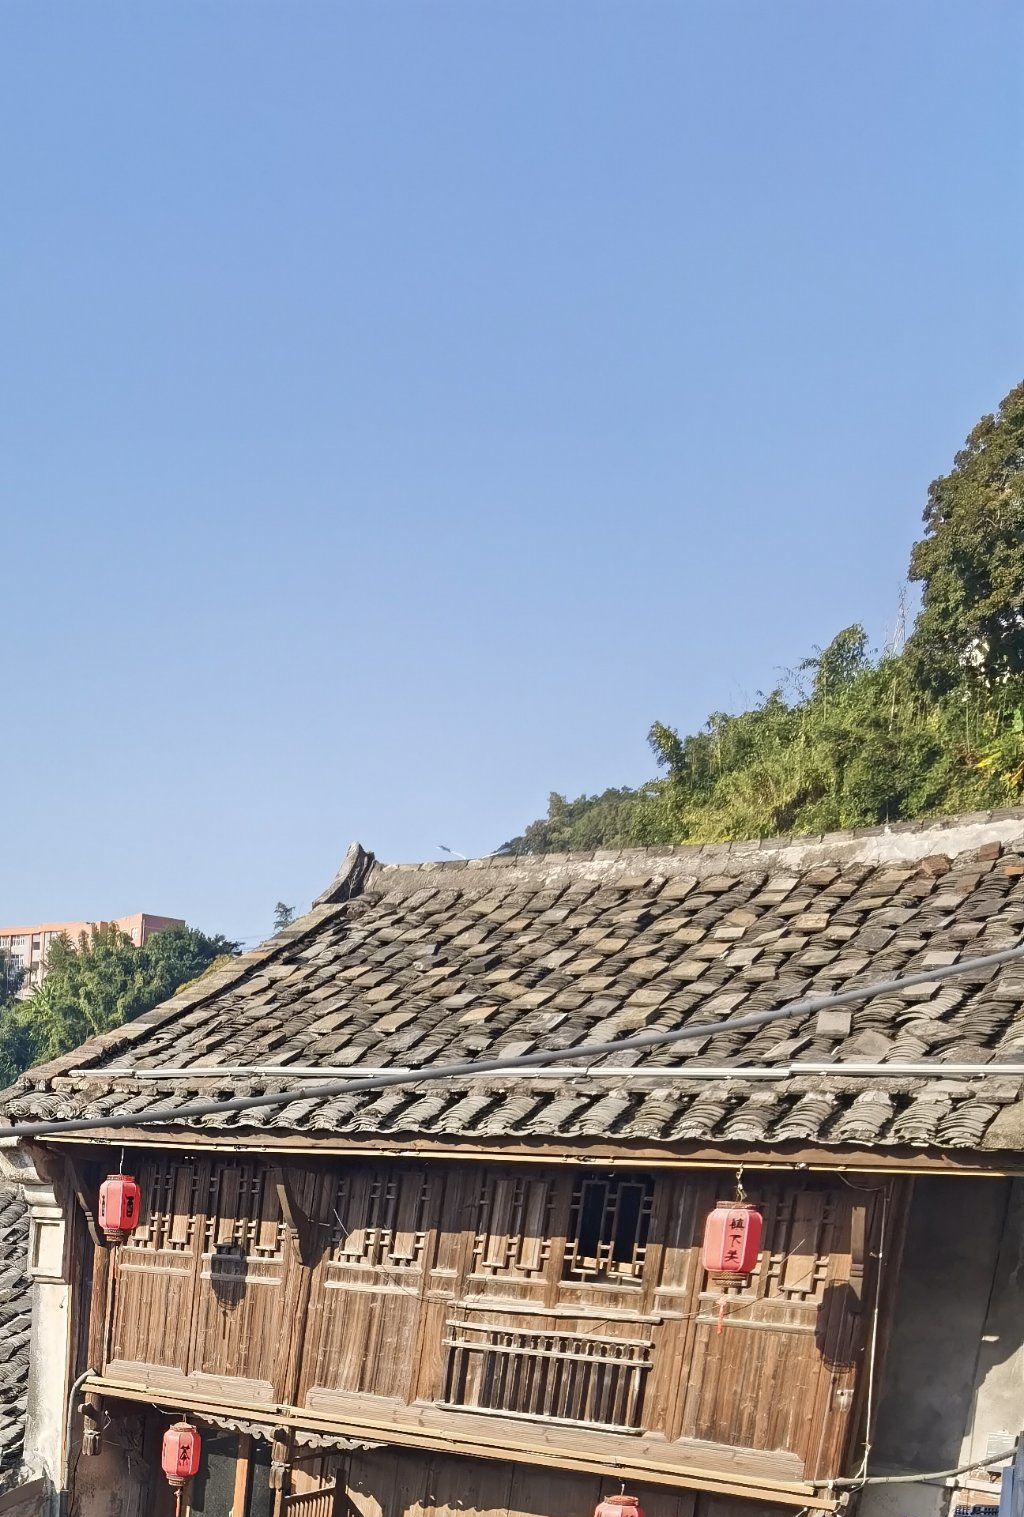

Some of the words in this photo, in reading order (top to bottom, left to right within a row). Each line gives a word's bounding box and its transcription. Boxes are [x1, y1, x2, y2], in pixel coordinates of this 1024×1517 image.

[724, 1217, 746, 1264] 镇下关
[179, 1444, 191, 1467] 茶
